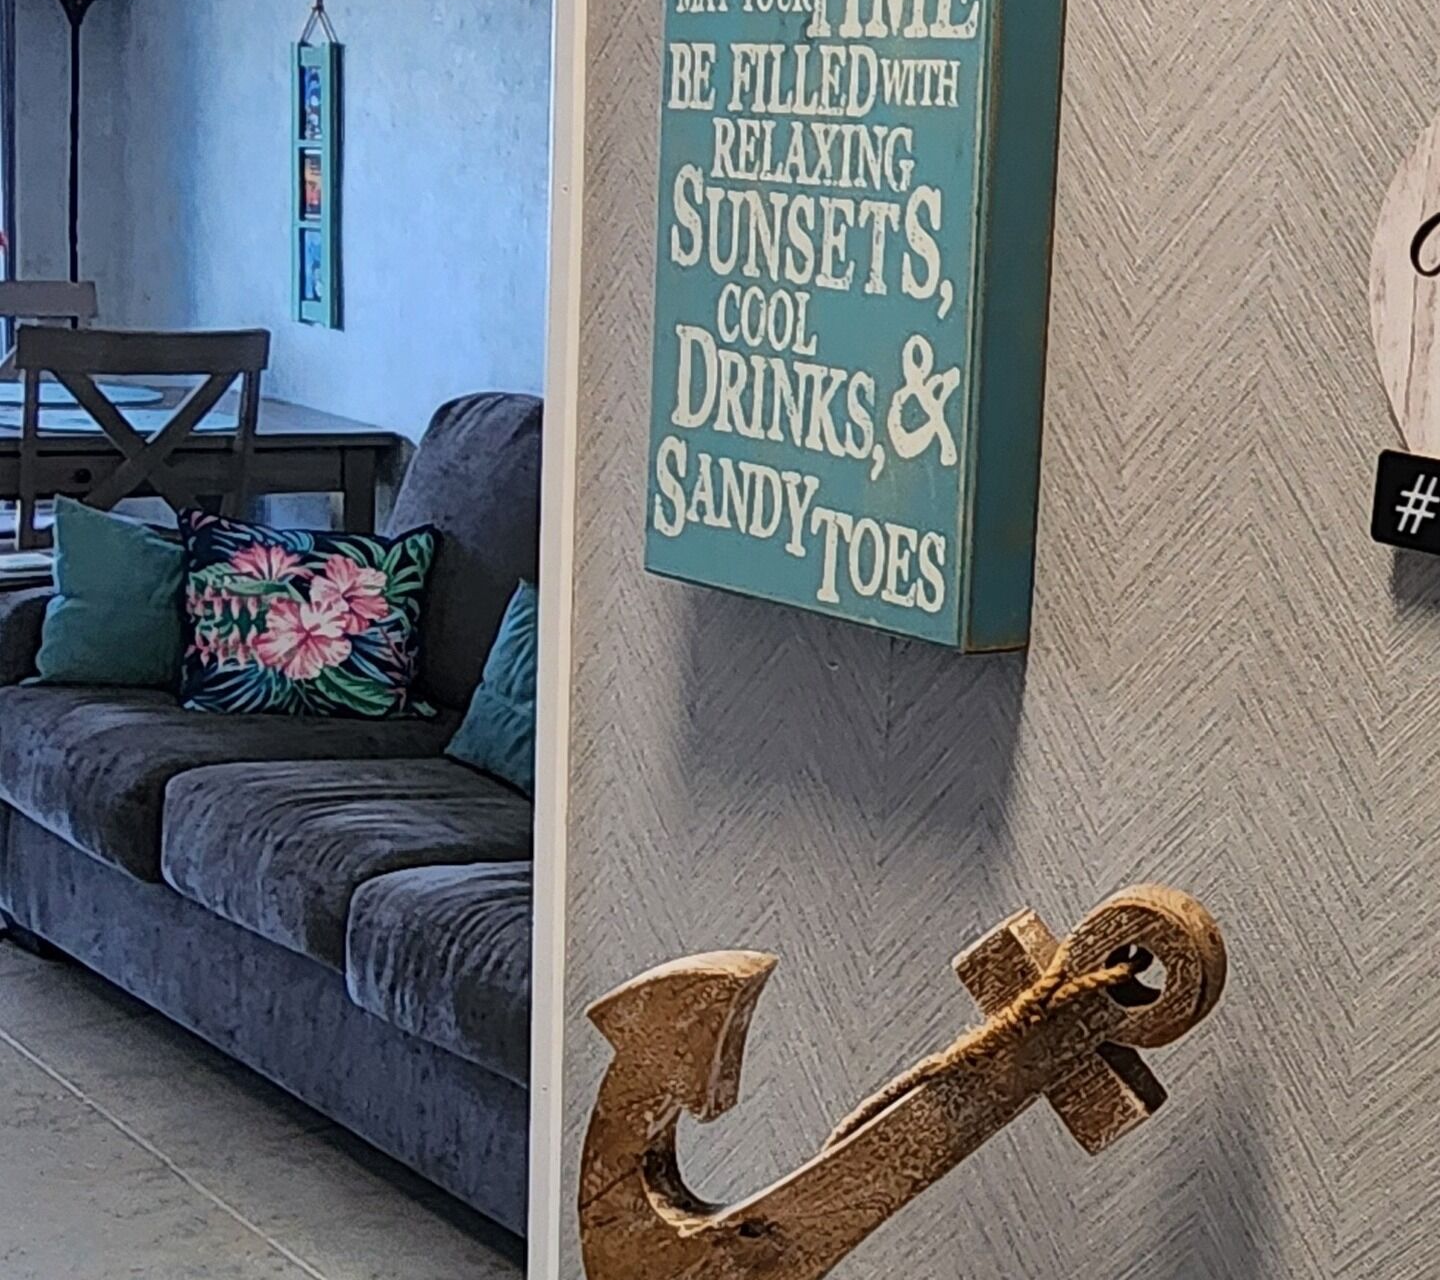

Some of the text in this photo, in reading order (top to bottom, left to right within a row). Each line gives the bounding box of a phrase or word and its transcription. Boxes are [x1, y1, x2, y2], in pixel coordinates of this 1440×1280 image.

[667, 42, 961, 118] BE FILLED WITH
[710, 117, 915, 193] RELAXING
[671, 163, 954, 320] SUNSETS,
[717, 282, 818, 356] COOL
[671, 324, 961, 481] DRINKS, &
[653, 436, 946, 613] SANDY TOES
